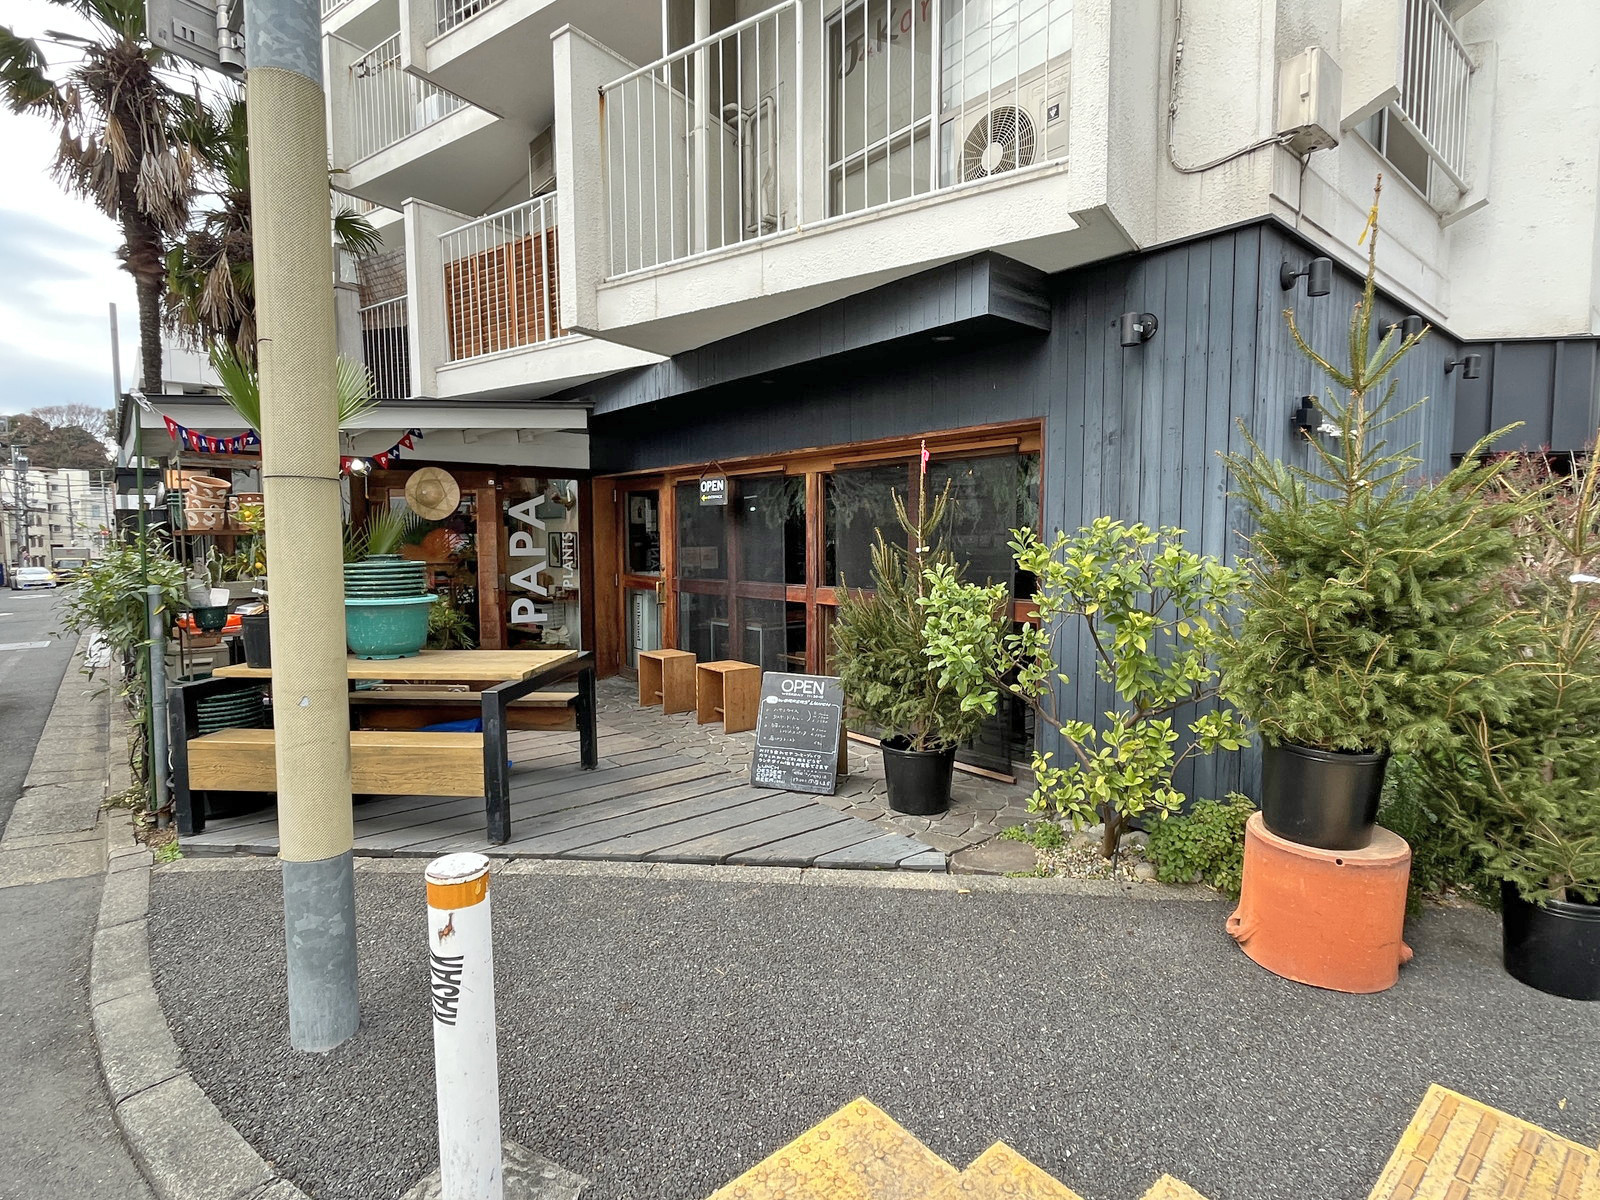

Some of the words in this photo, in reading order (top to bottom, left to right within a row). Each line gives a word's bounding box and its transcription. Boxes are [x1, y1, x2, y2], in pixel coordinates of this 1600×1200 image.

[701, 480, 724, 492] OPEN
[508, 494, 548, 623] PAPA
[562, 532, 574, 588] PLANTS
[781, 679, 825, 695] OPEN
